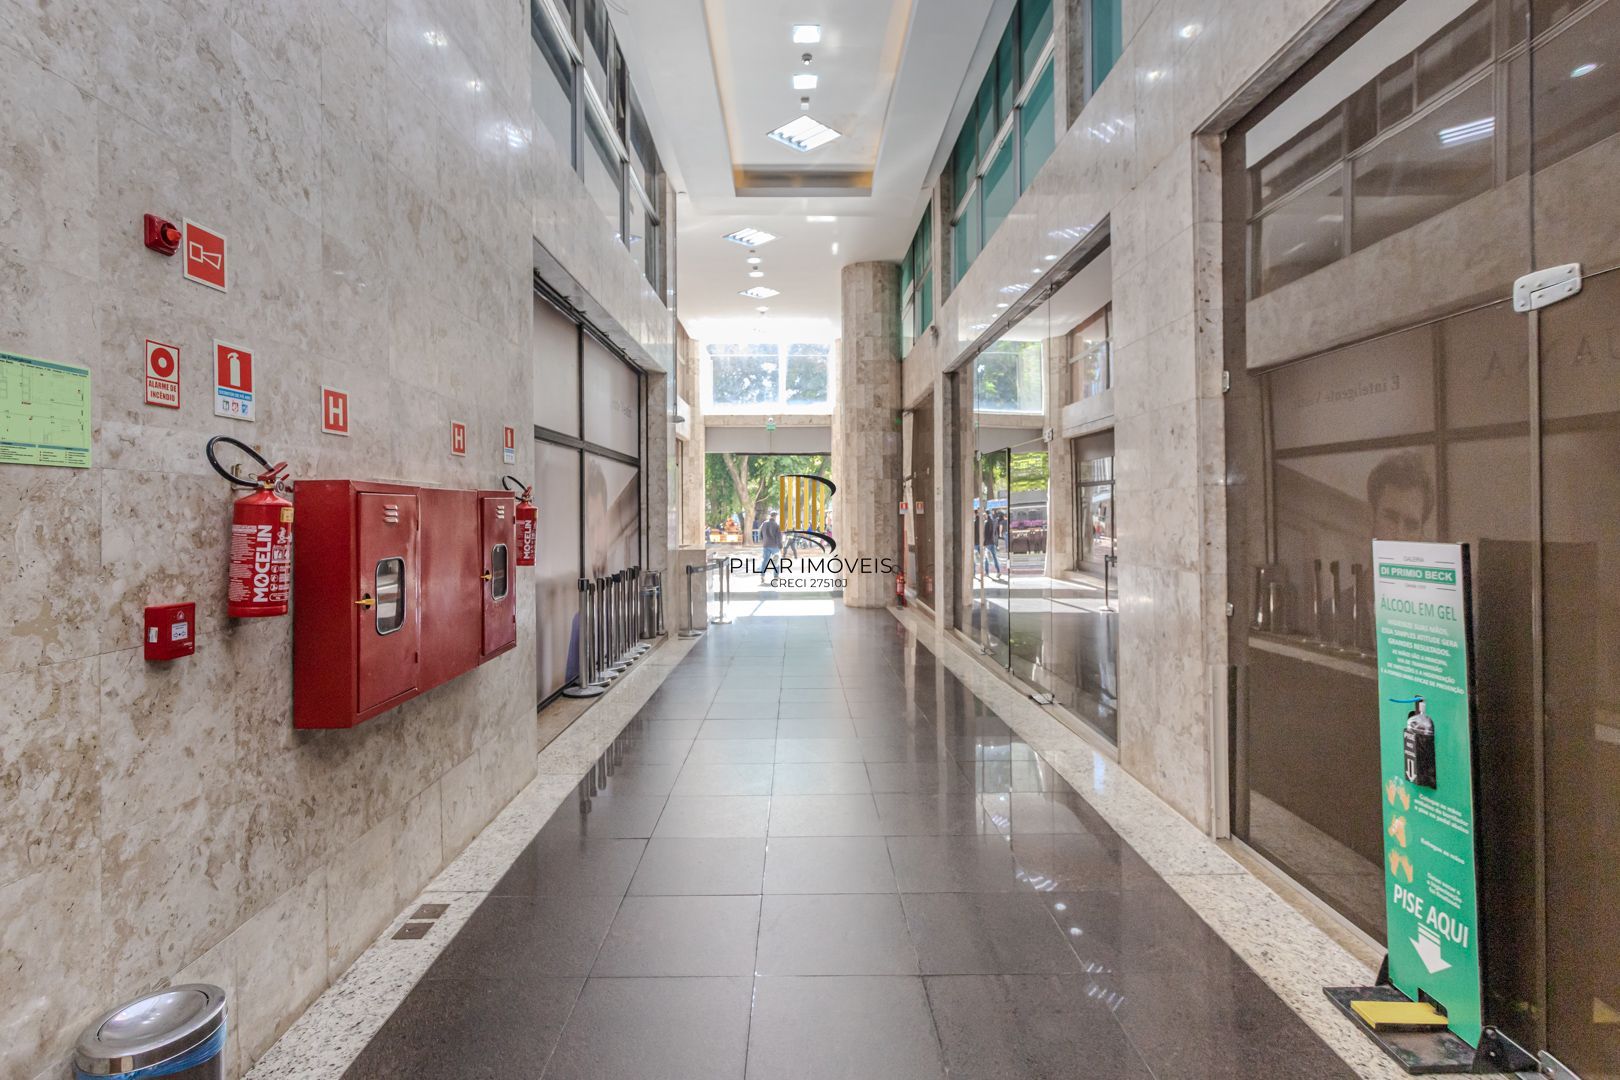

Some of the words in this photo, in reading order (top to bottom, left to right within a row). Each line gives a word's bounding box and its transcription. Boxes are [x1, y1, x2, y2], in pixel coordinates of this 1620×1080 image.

[148, 379, 169, 391] ALARME
[170, 383, 177, 392] DE
[150, 389, 175, 402] INCÊNDIO
[329, 396, 343, 427] H
[455, 427, 463, 450] H
[523, 520, 532, 559] MOCELIN
[253, 525, 272, 602] MOCELIN
[1380, 566, 1389, 575] DI
[1391, 567, 1423, 579] PRIMIO
[1425, 570, 1453, 581] BECK
[1380, 593, 1416, 615] ÁLCOOL
[1419, 602, 1434, 617] EM
[1437, 605, 1457, 621] GEL
[1393, 883, 1424, 919] PISE
[1427, 906, 1469, 948] AQUI
